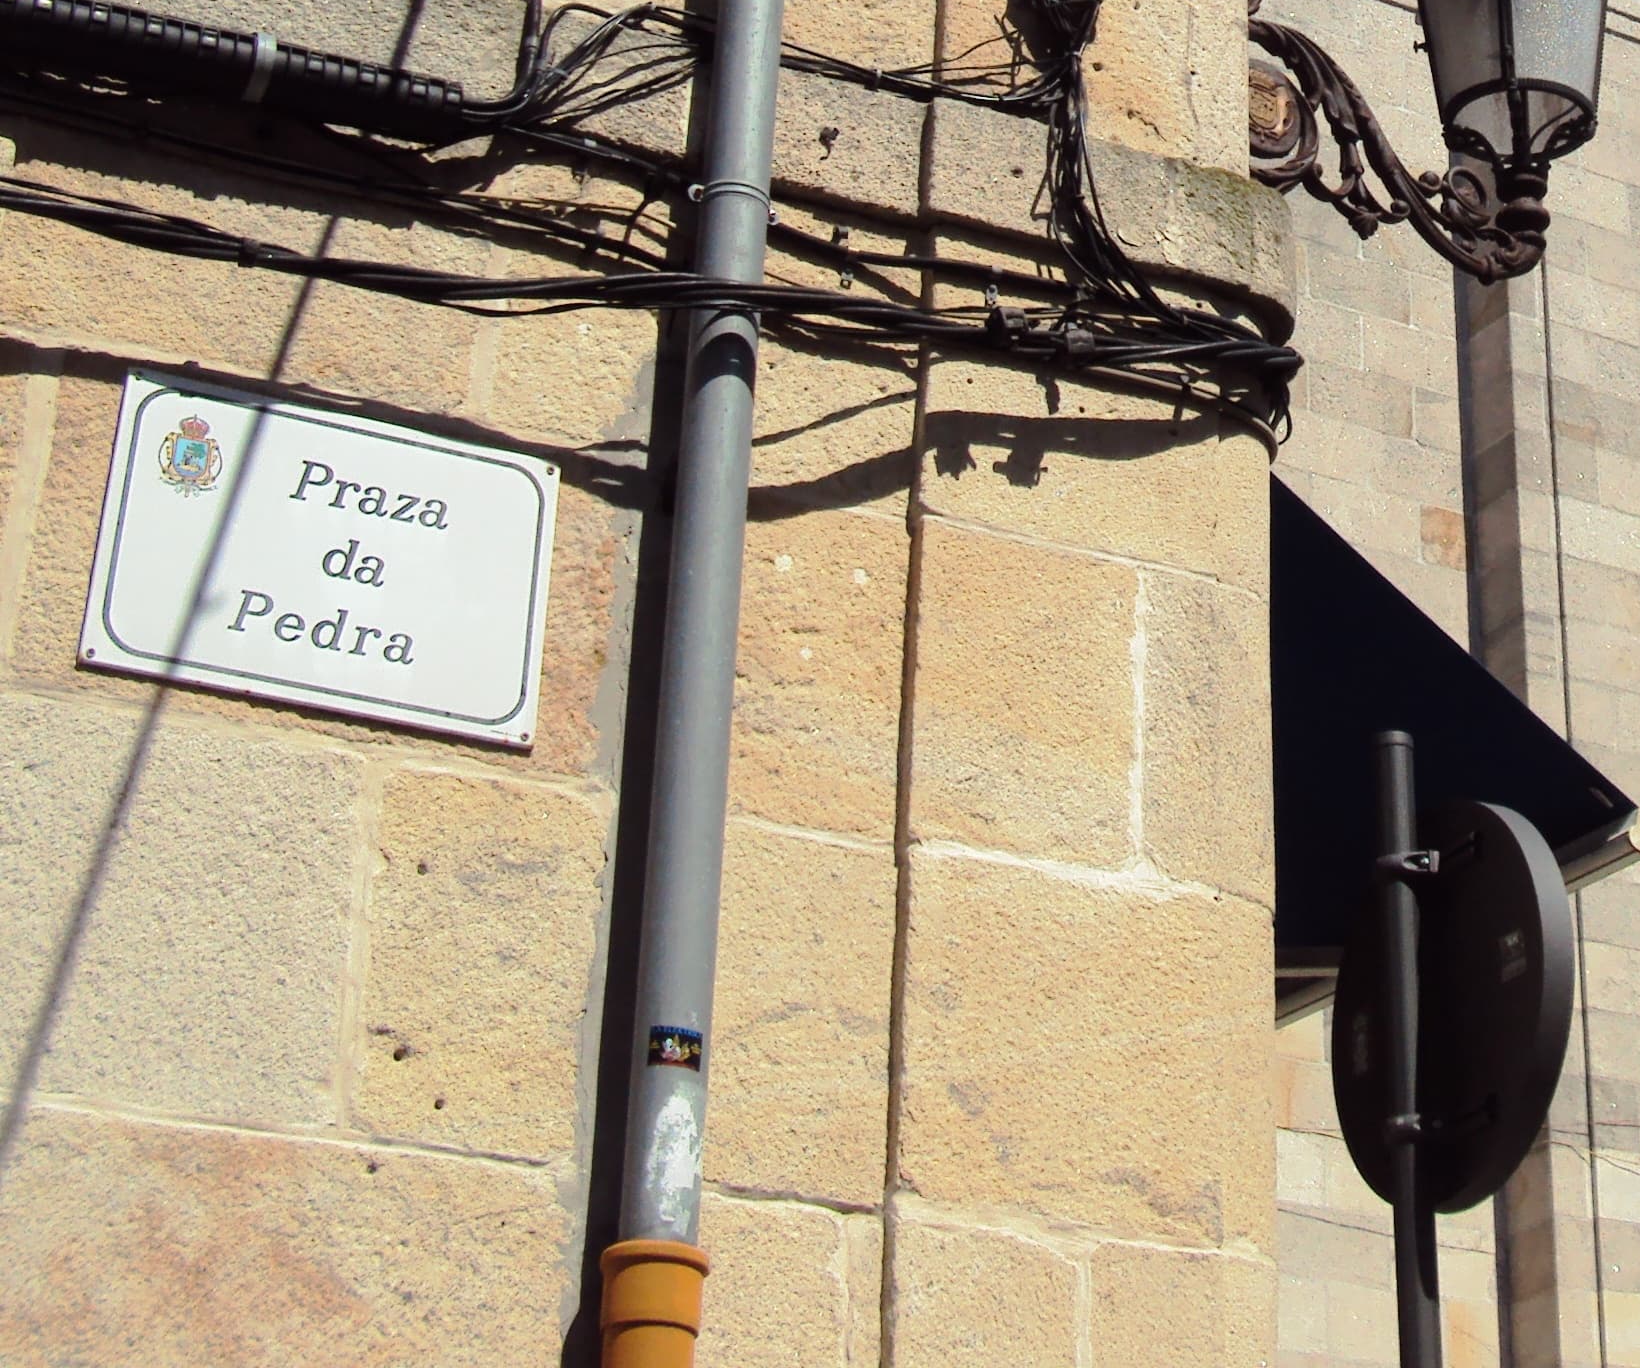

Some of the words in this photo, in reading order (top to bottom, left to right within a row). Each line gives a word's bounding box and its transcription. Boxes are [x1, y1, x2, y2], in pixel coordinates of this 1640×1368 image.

[289, 460, 449, 530] Praza
[321, 539, 385, 588] da
[227, 589, 414, 666] Pedra
